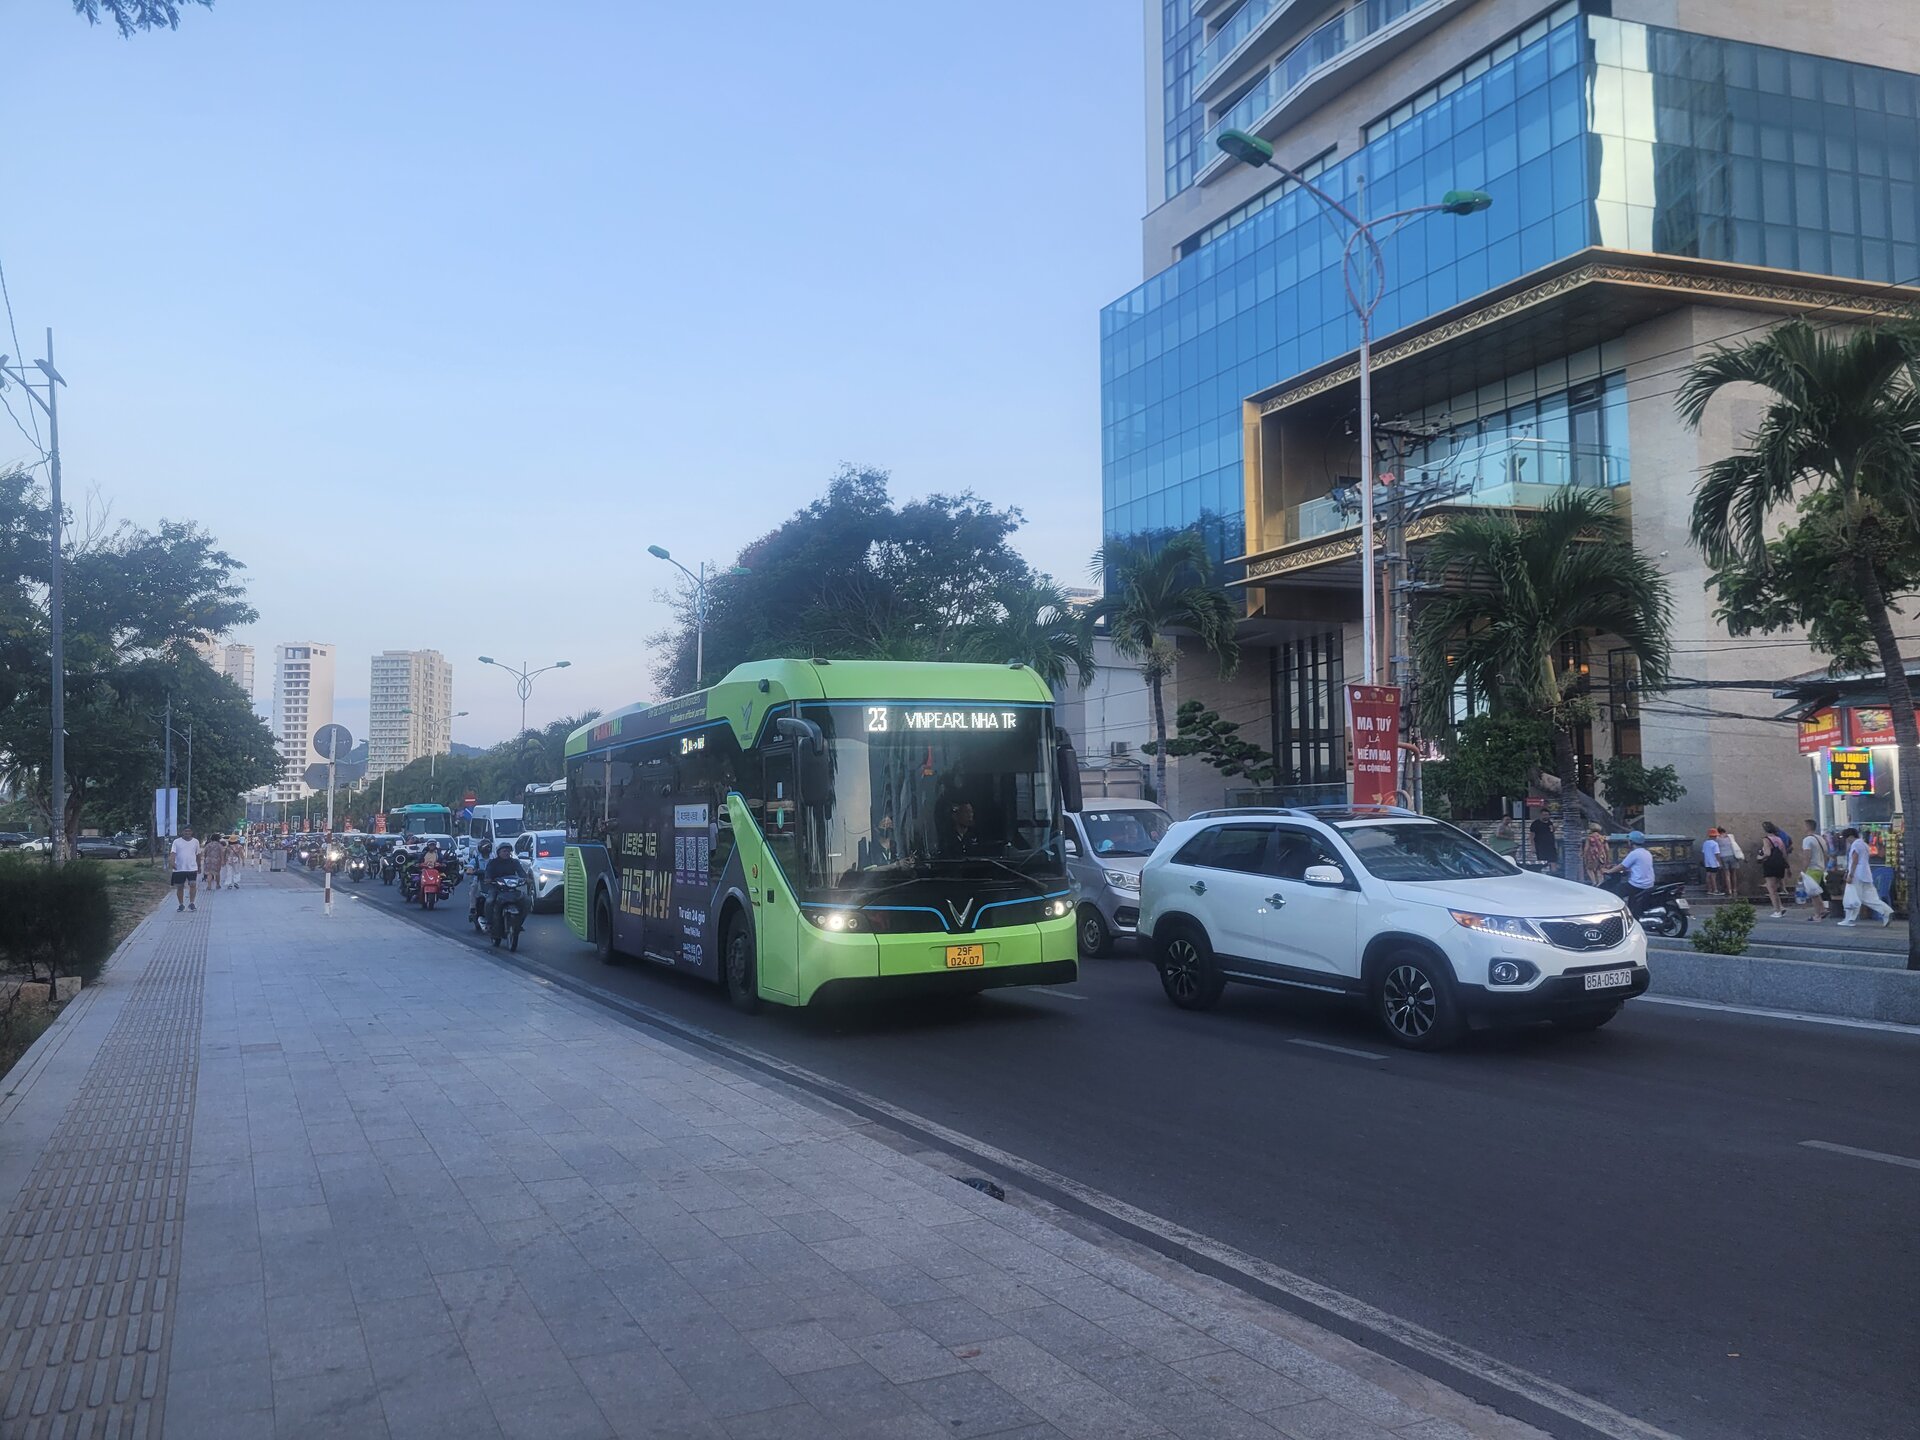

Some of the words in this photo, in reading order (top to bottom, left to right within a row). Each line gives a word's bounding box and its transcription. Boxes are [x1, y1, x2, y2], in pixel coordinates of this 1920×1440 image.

[868, 707, 888, 732] 23
[905, 712, 968, 729] VINPEARL
[972, 712, 998, 729] NHA
[1357, 717, 1373, 731] MA
[1376, 716, 1392, 732] TUÝ
[622, 832, 643, 856] 나트랑은
[957, 947, 973, 957] 29F
[951, 956, 980, 966] 024.07
[1587, 971, 1631, 989] 85A-053.76
